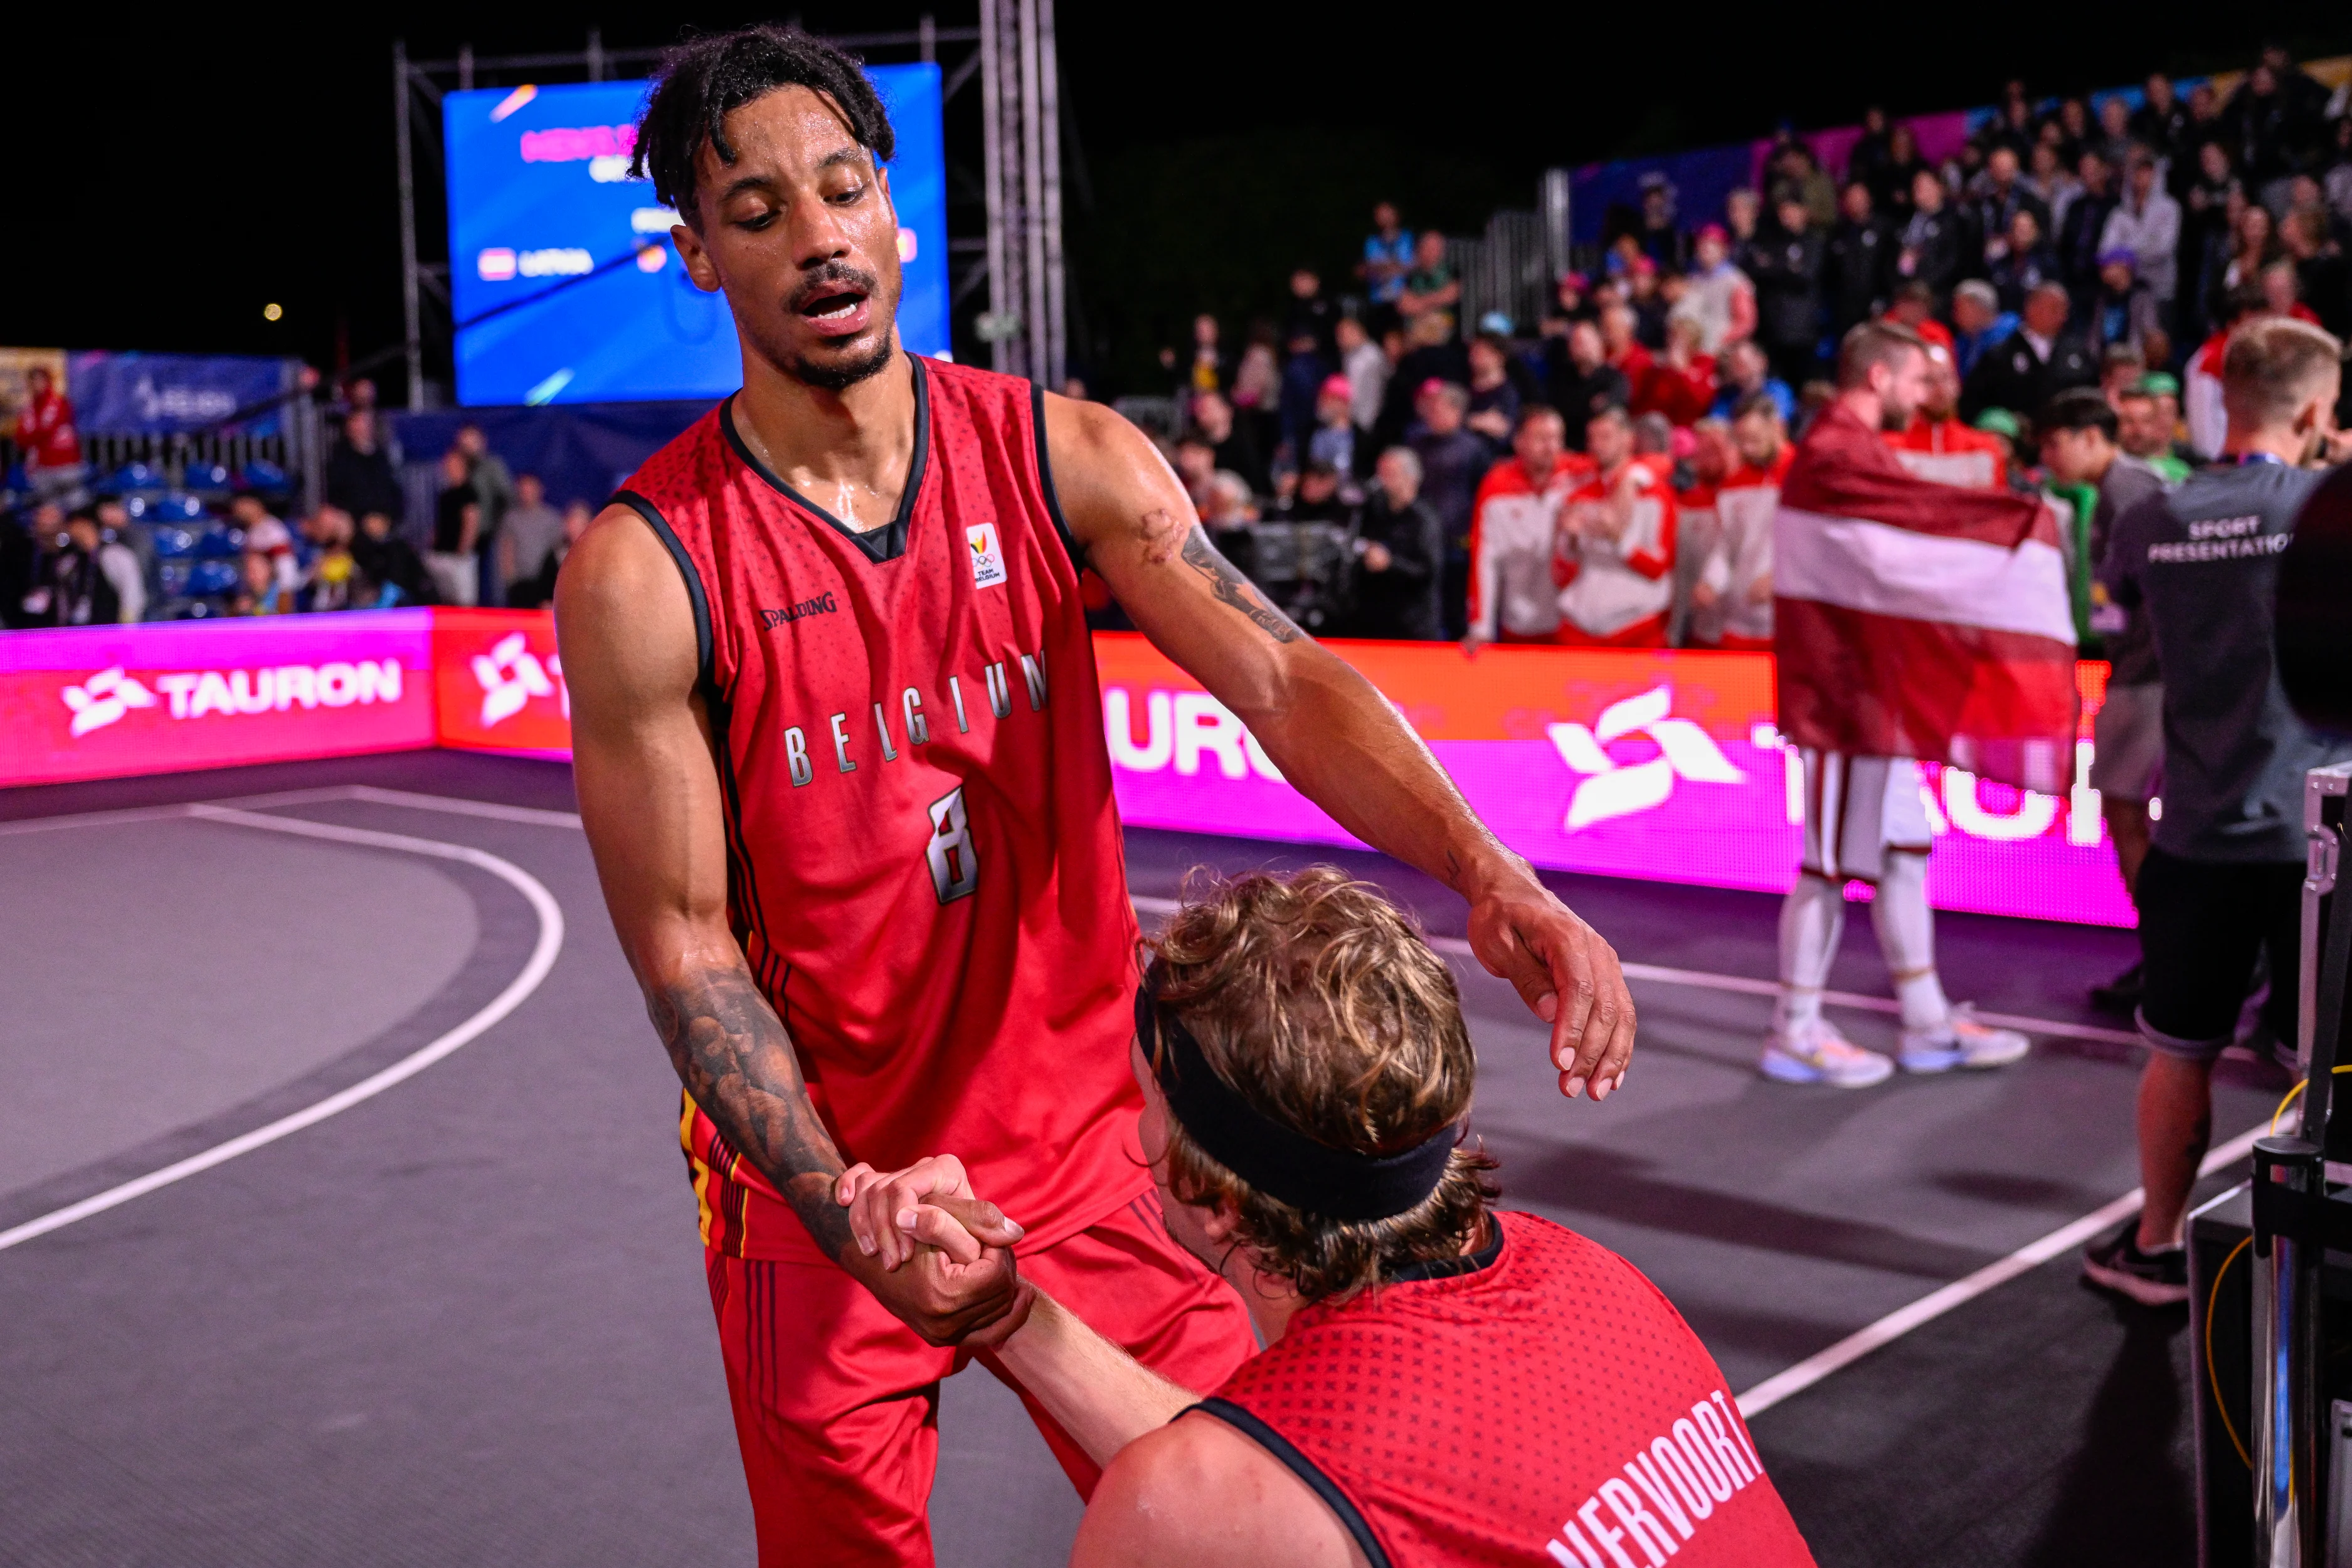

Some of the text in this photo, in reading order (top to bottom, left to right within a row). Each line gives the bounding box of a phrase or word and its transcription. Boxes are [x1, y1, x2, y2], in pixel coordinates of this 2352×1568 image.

[2189, 515, 2260, 541] SPORT
[2148, 532, 2294, 563] PRESENTATIO
[975, 572, 1000, 583] BELGIUM
[977, 568, 994, 576] TEAM
[760, 591, 838, 632] SPALDING
[157, 658, 403, 719] TAURON
[926, 787, 979, 904] 8
